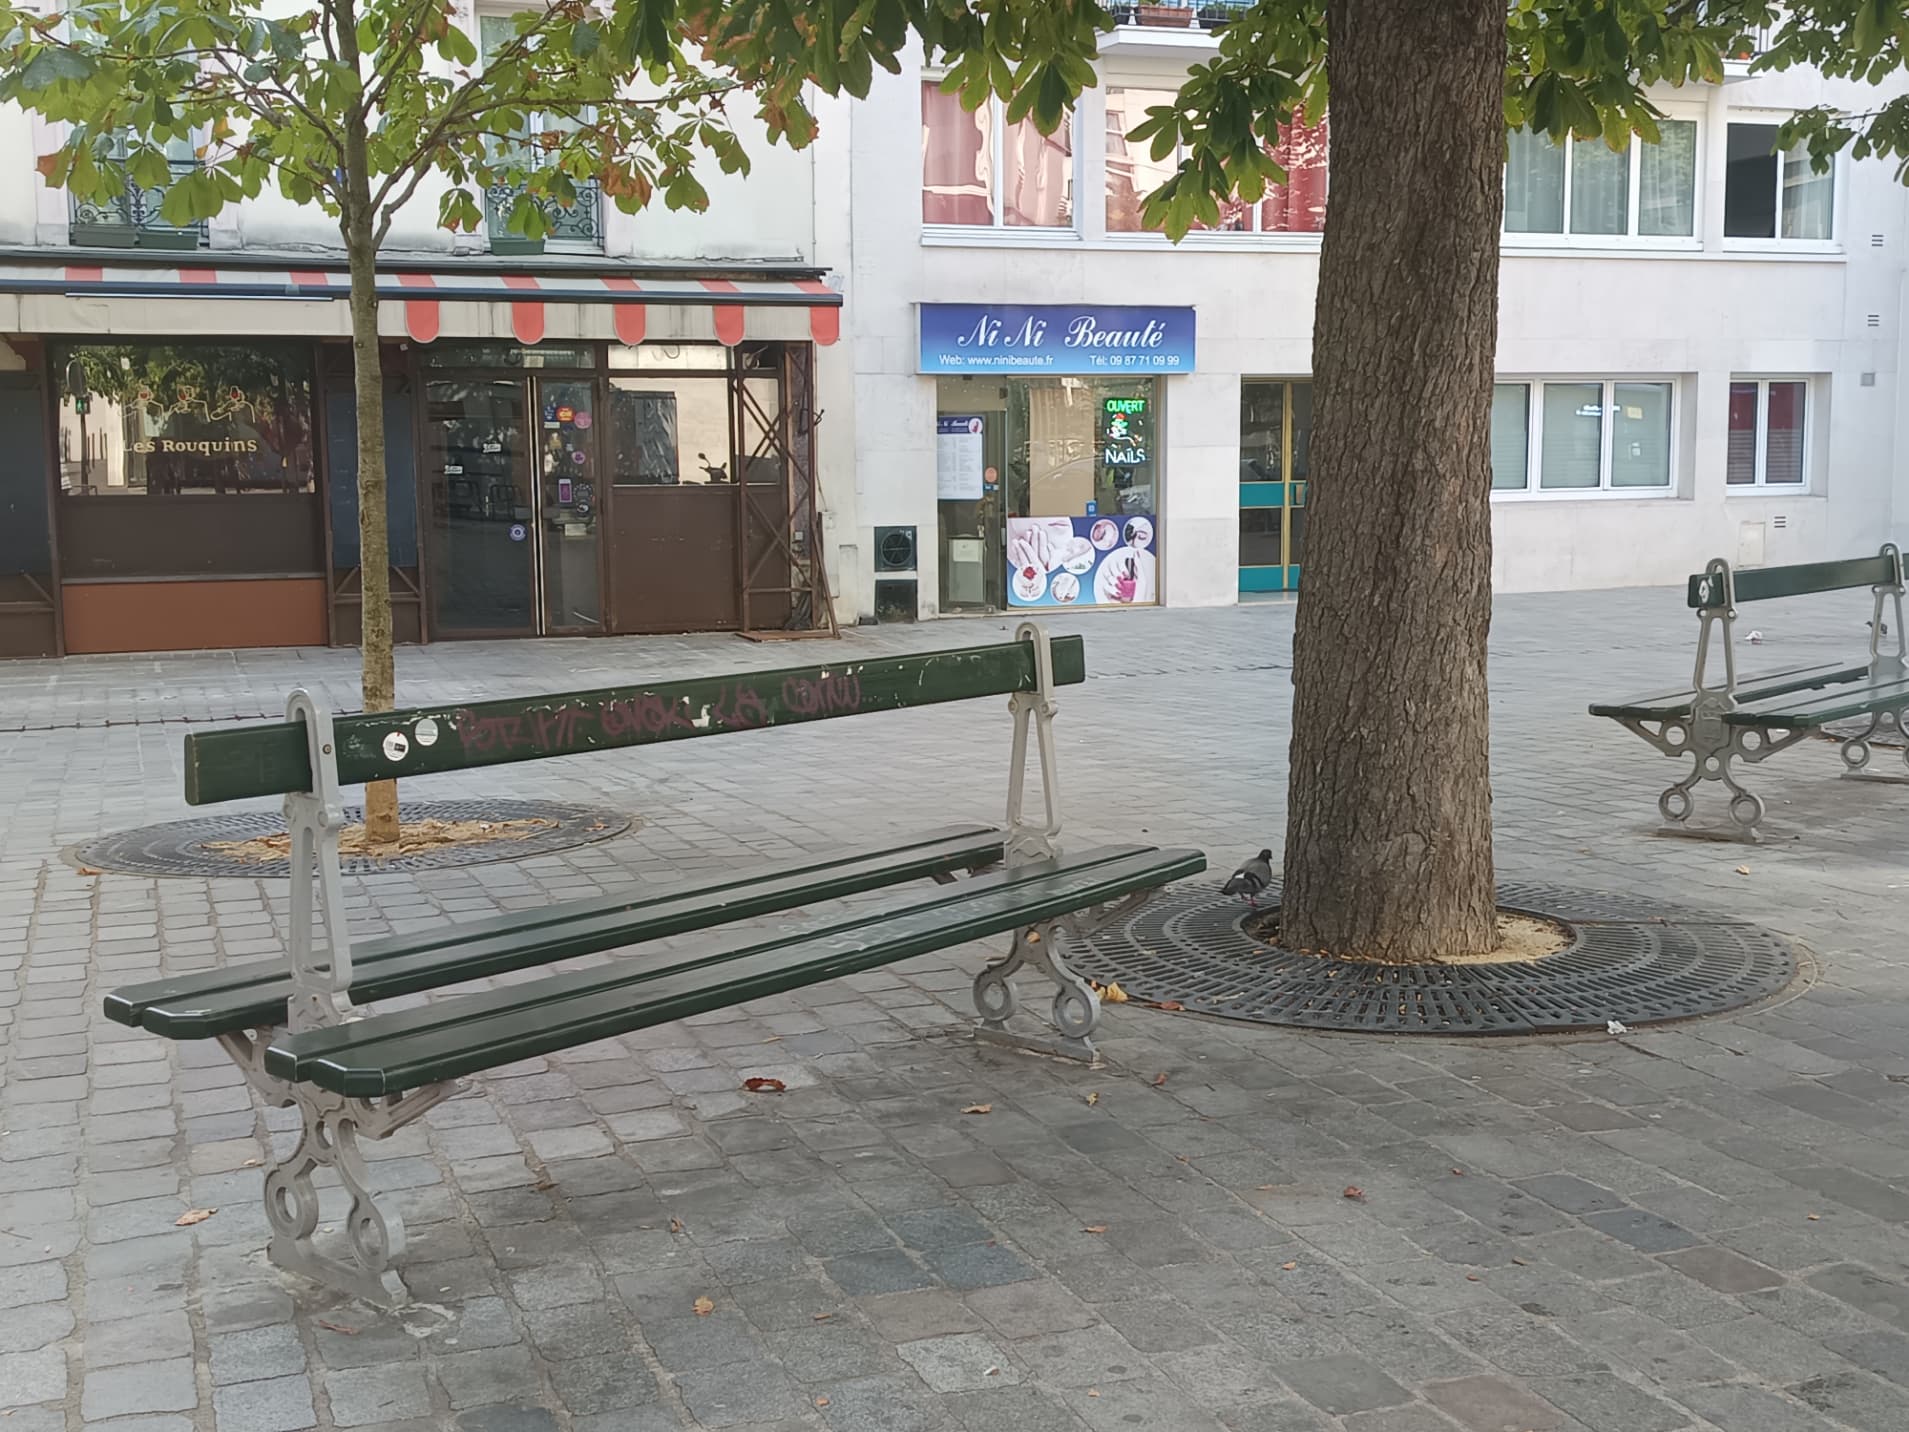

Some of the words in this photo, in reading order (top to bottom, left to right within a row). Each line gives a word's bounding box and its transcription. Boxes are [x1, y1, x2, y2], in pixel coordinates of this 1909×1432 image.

[957, 314, 1002, 347] Ni
[1003, 315, 1047, 347] Ni
[1063, 315, 1166, 348] Beauté
[938, 354, 966, 366] Web:
[1089, 354, 1108, 366] Tél:
[1109, 355, 1122, 366] 09
[1124, 355, 1137, 366] 87
[1139, 355, 1150, 366] 71
[1152, 355, 1165, 366] 09
[1167, 355, 1180, 367] 99
[1106, 399, 1146, 413] OUVERT
[123, 439, 156, 453] Les
[161, 436, 258, 457] Rouquins
